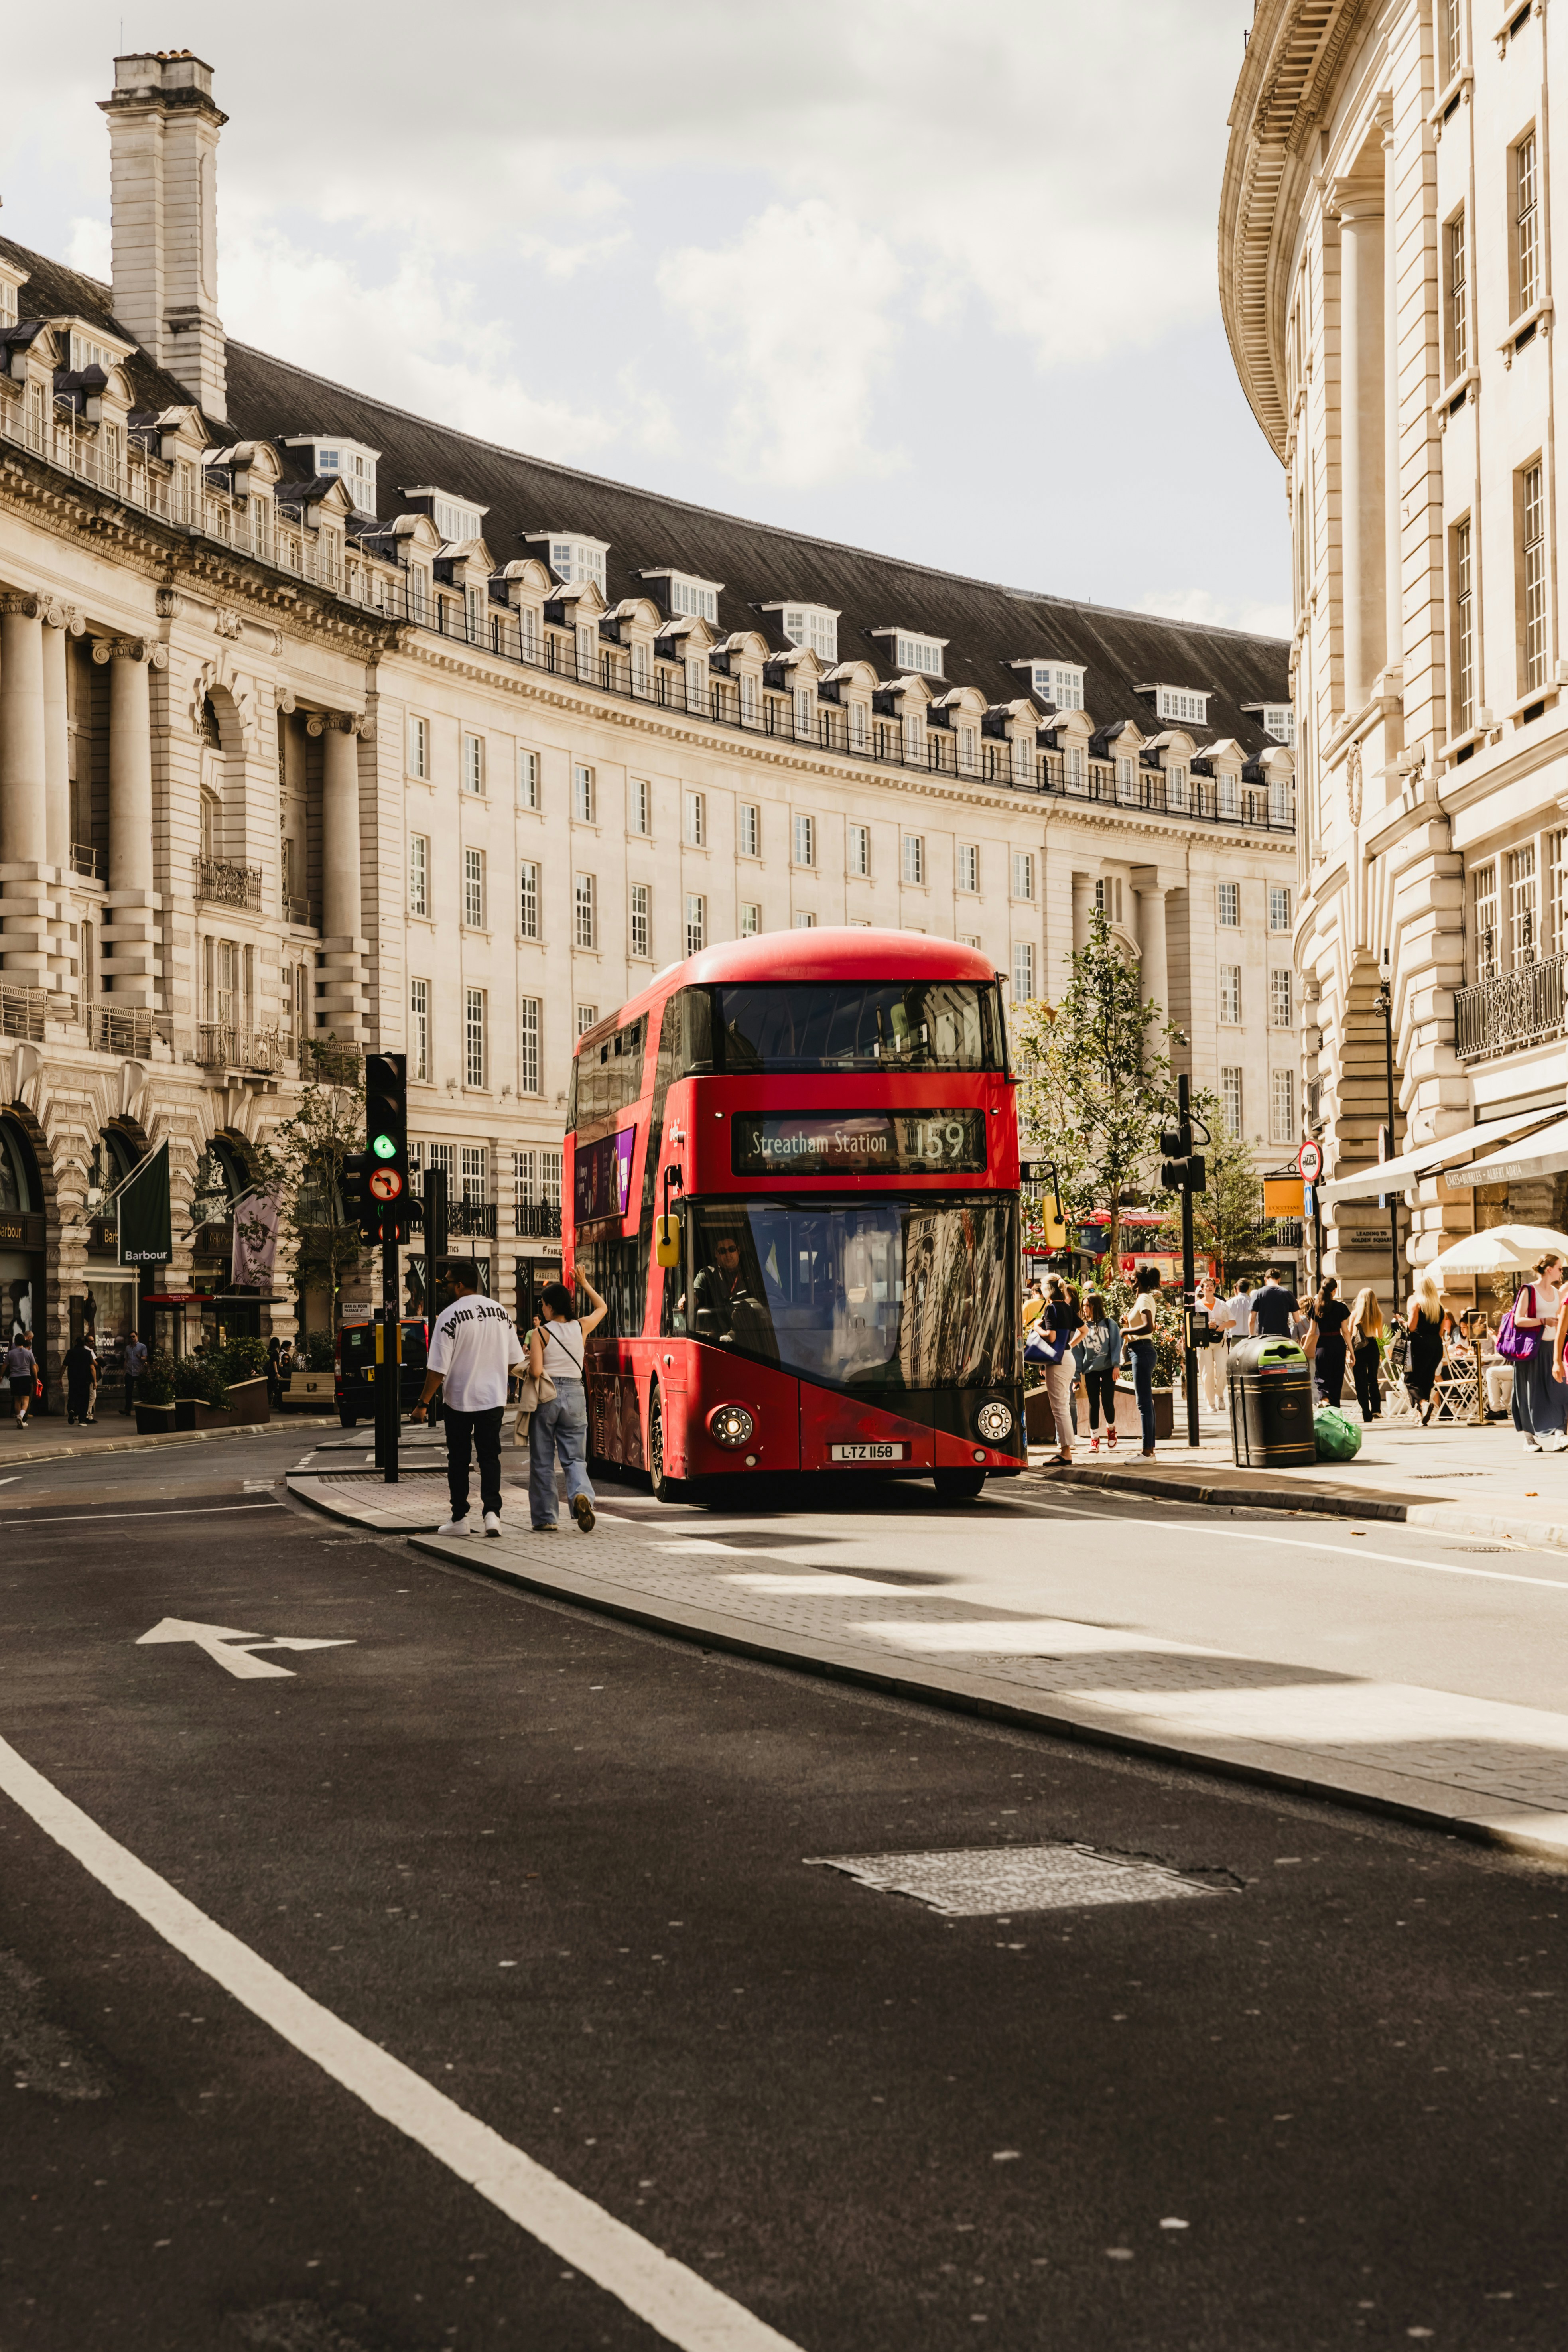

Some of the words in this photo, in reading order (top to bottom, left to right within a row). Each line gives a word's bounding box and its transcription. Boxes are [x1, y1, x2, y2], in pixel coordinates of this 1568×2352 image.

[753, 1131, 828, 1154] Streatham
[835, 1130, 887, 1152] Station
[917, 1122, 964, 1158] 159
[1487, 1167, 1505, 1180] ALBERT
[0, 1223, 22, 1238] arbour
[125, 1250, 167, 1260] Barbour
[440, 1309, 475, 1339] Palm
[95, 1334, 115, 1346] Barbour
[842, 1446, 866, 1458] LTZ
[870, 1446, 892, 1458] 1158
